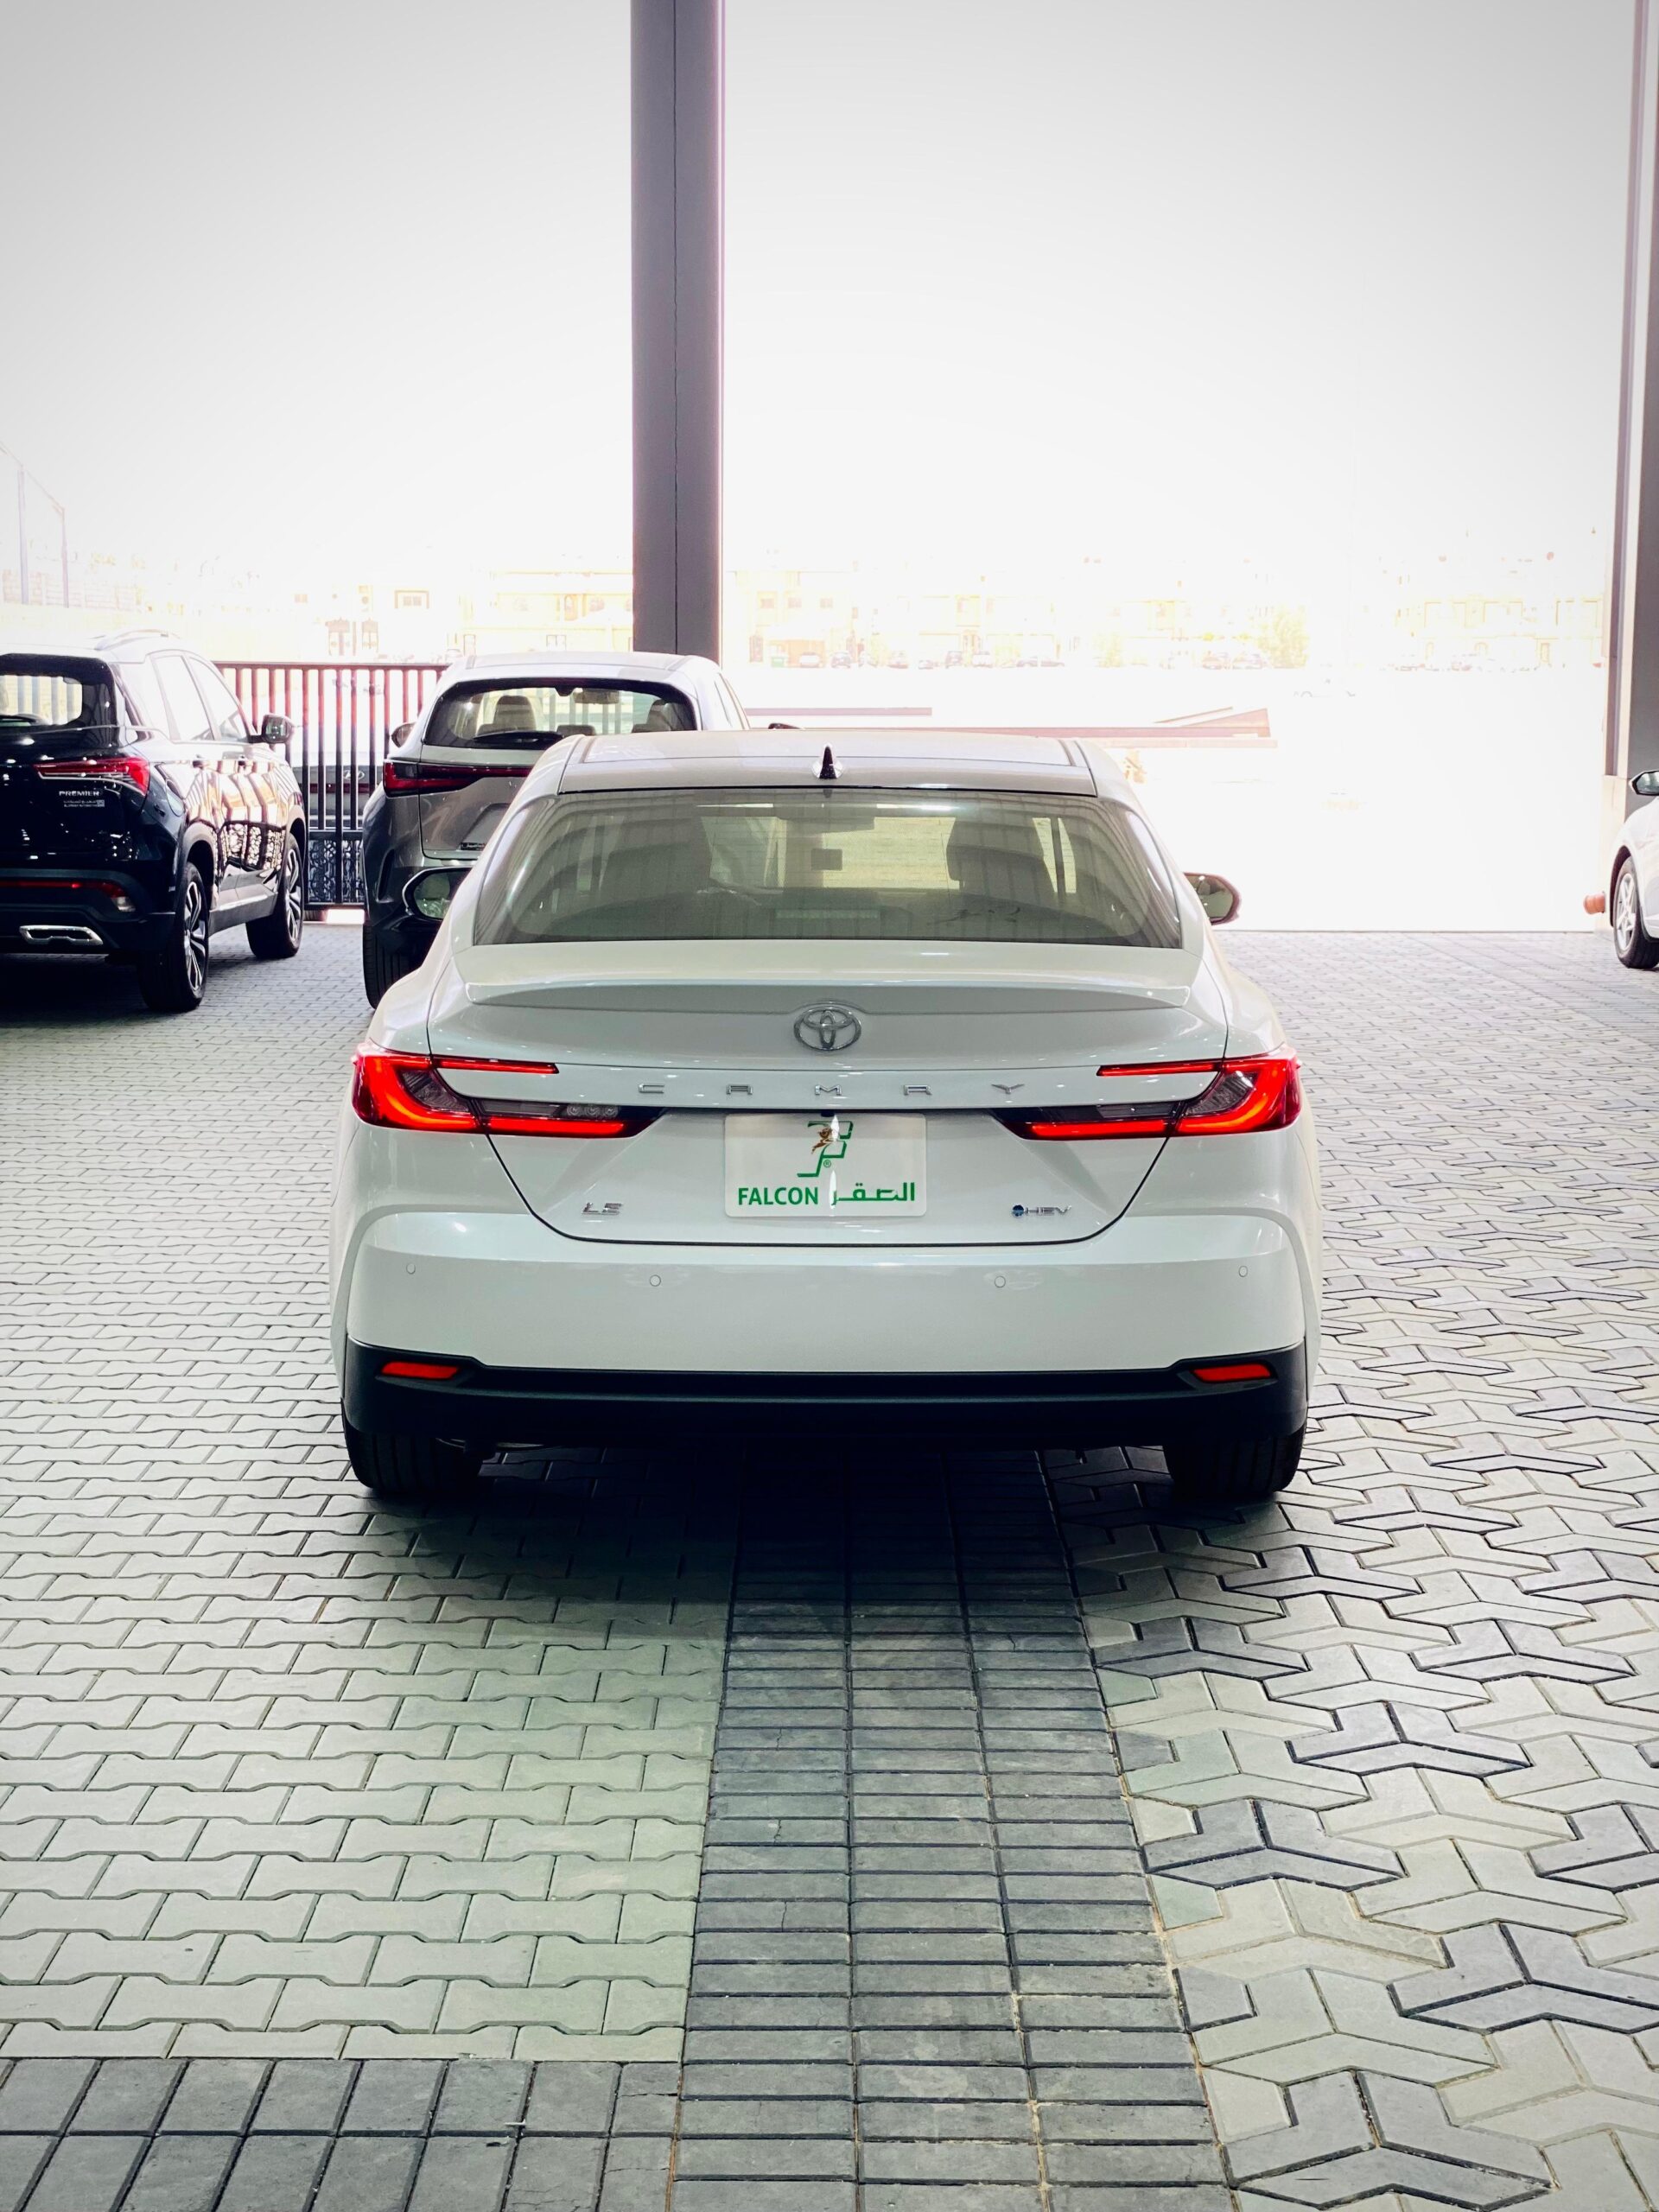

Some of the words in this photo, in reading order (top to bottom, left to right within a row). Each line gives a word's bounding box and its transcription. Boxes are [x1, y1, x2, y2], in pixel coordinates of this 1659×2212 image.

[638, 1083, 1025, 1096] CAMRY
[737, 1186, 819, 1205] FALCON
[830, 1181, 916, 1206] الصقر
[582, 1201, 623, 1216] LE
[1024, 1205, 1072, 1217] HEV
